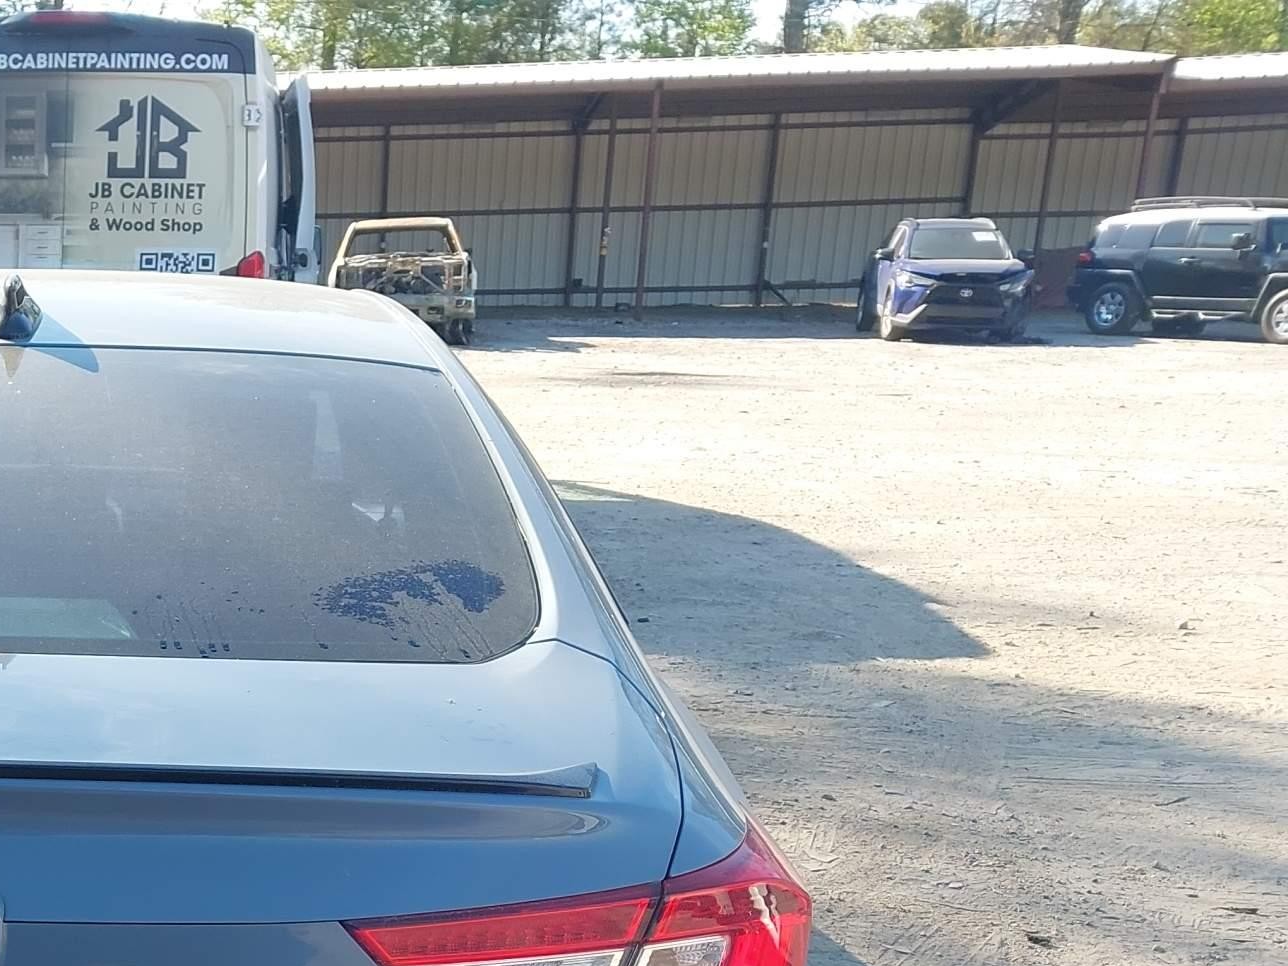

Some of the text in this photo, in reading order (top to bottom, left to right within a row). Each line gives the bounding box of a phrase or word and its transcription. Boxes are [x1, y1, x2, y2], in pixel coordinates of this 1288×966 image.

[88, 182, 206, 200] JB CABINET
[89, 201, 203, 216] PAINTING
[88, 217, 204, 235] & Wood Shop
